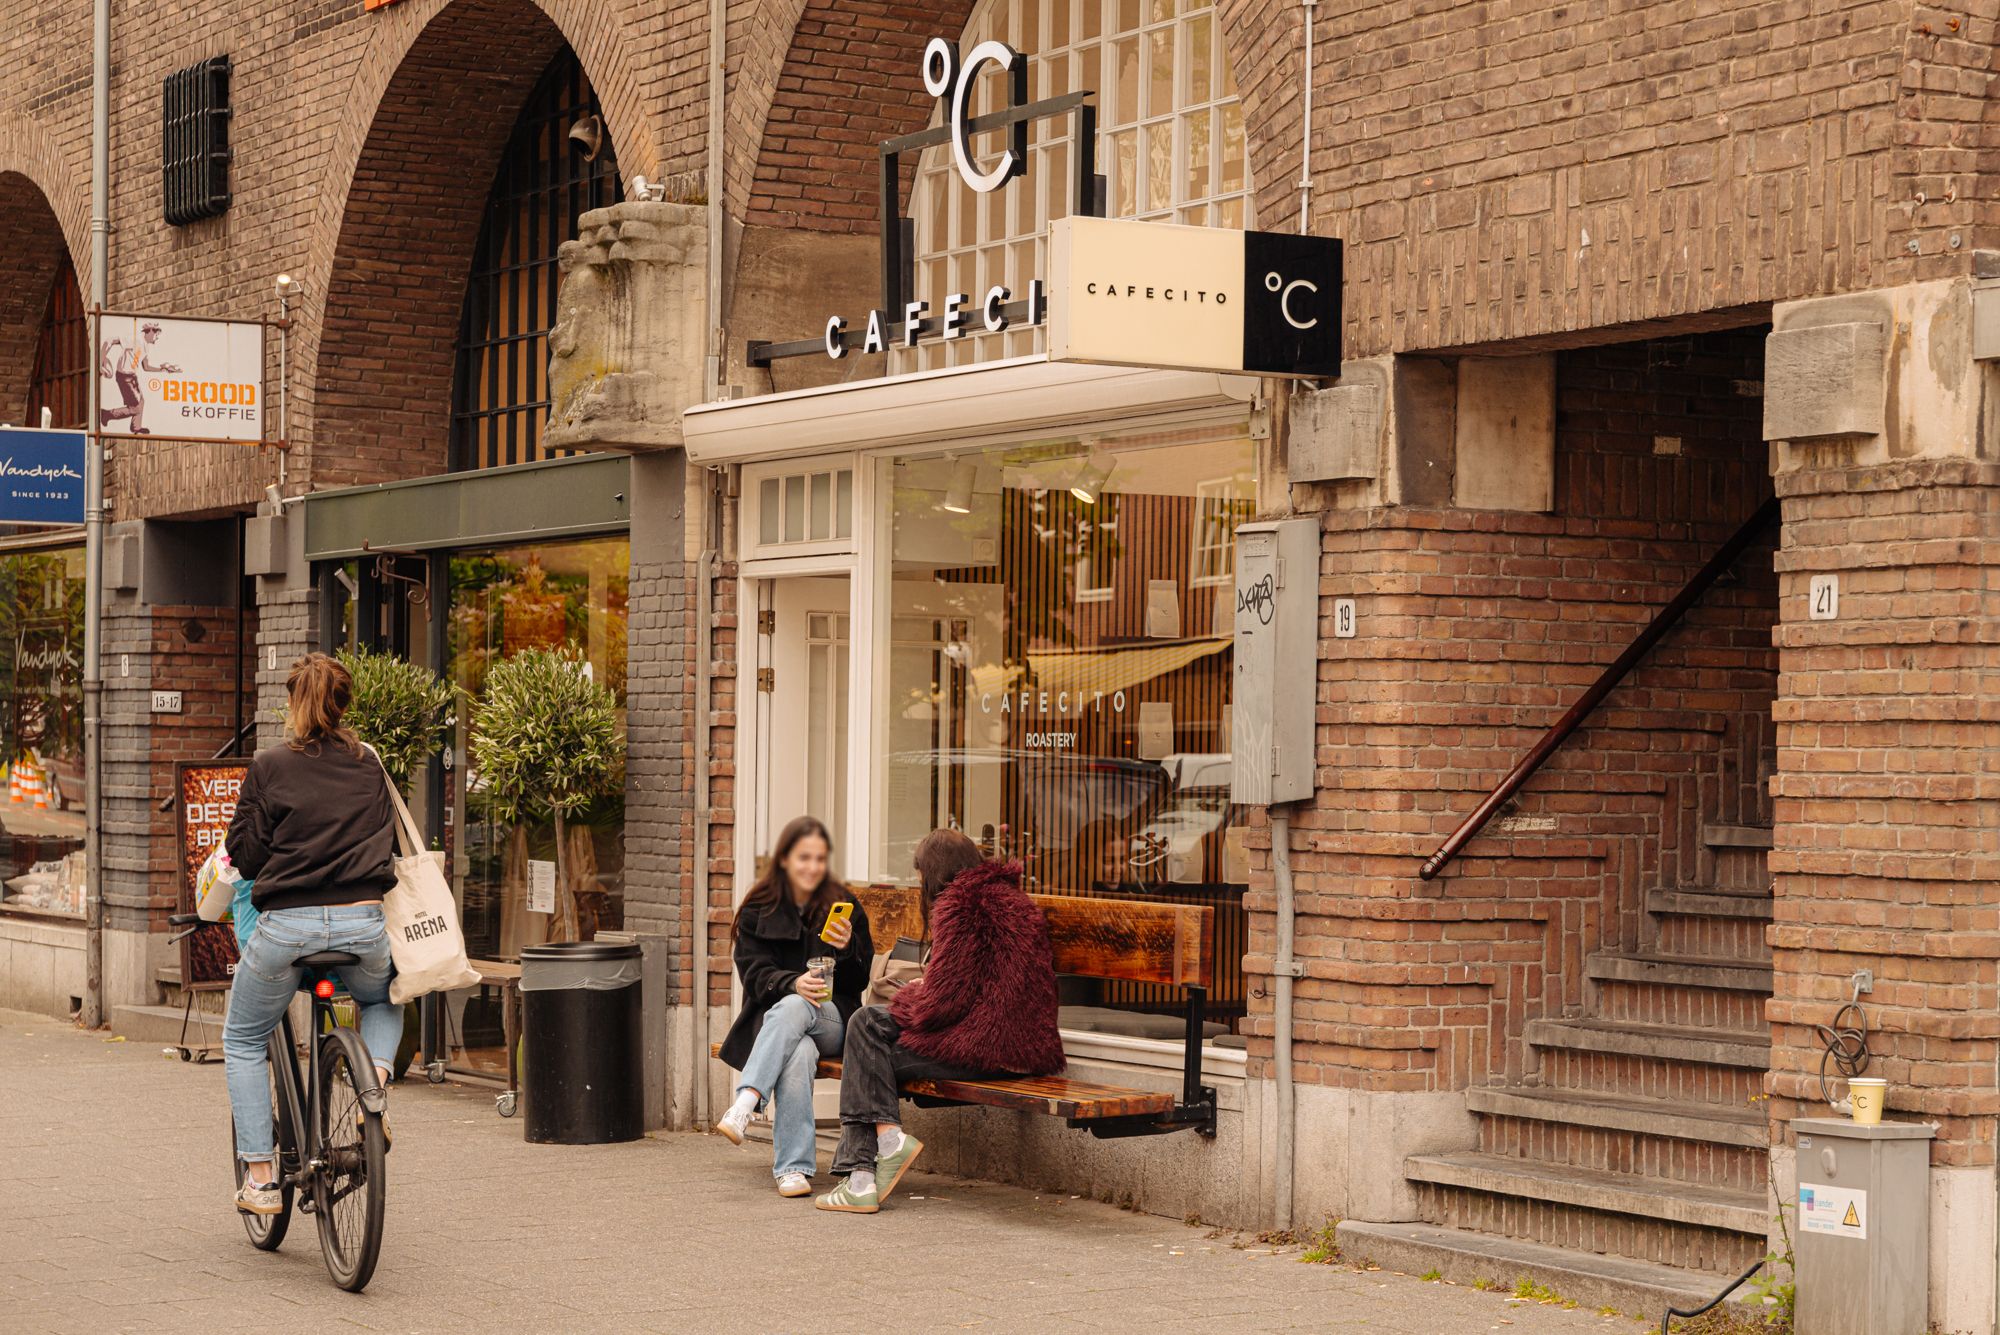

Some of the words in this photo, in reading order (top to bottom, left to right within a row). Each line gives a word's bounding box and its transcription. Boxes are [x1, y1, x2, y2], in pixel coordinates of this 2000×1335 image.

[1087, 282, 1227, 304] CAFECITO
[163, 380, 256, 406] BROOD
[181, 406, 256, 420] &KOFFIE
[0, 456, 82, 482] Vandyck
[1816, 584, 1832, 613] 21
[1339, 604, 1351, 632] 19
[155, 696, 180, 709] 15-17
[981, 690, 1126, 714] CAFECITO
[1026, 732, 1077, 748] ROASTERY
[201, 779, 245, 797] VER
[404, 915, 448, 943] ARENA
